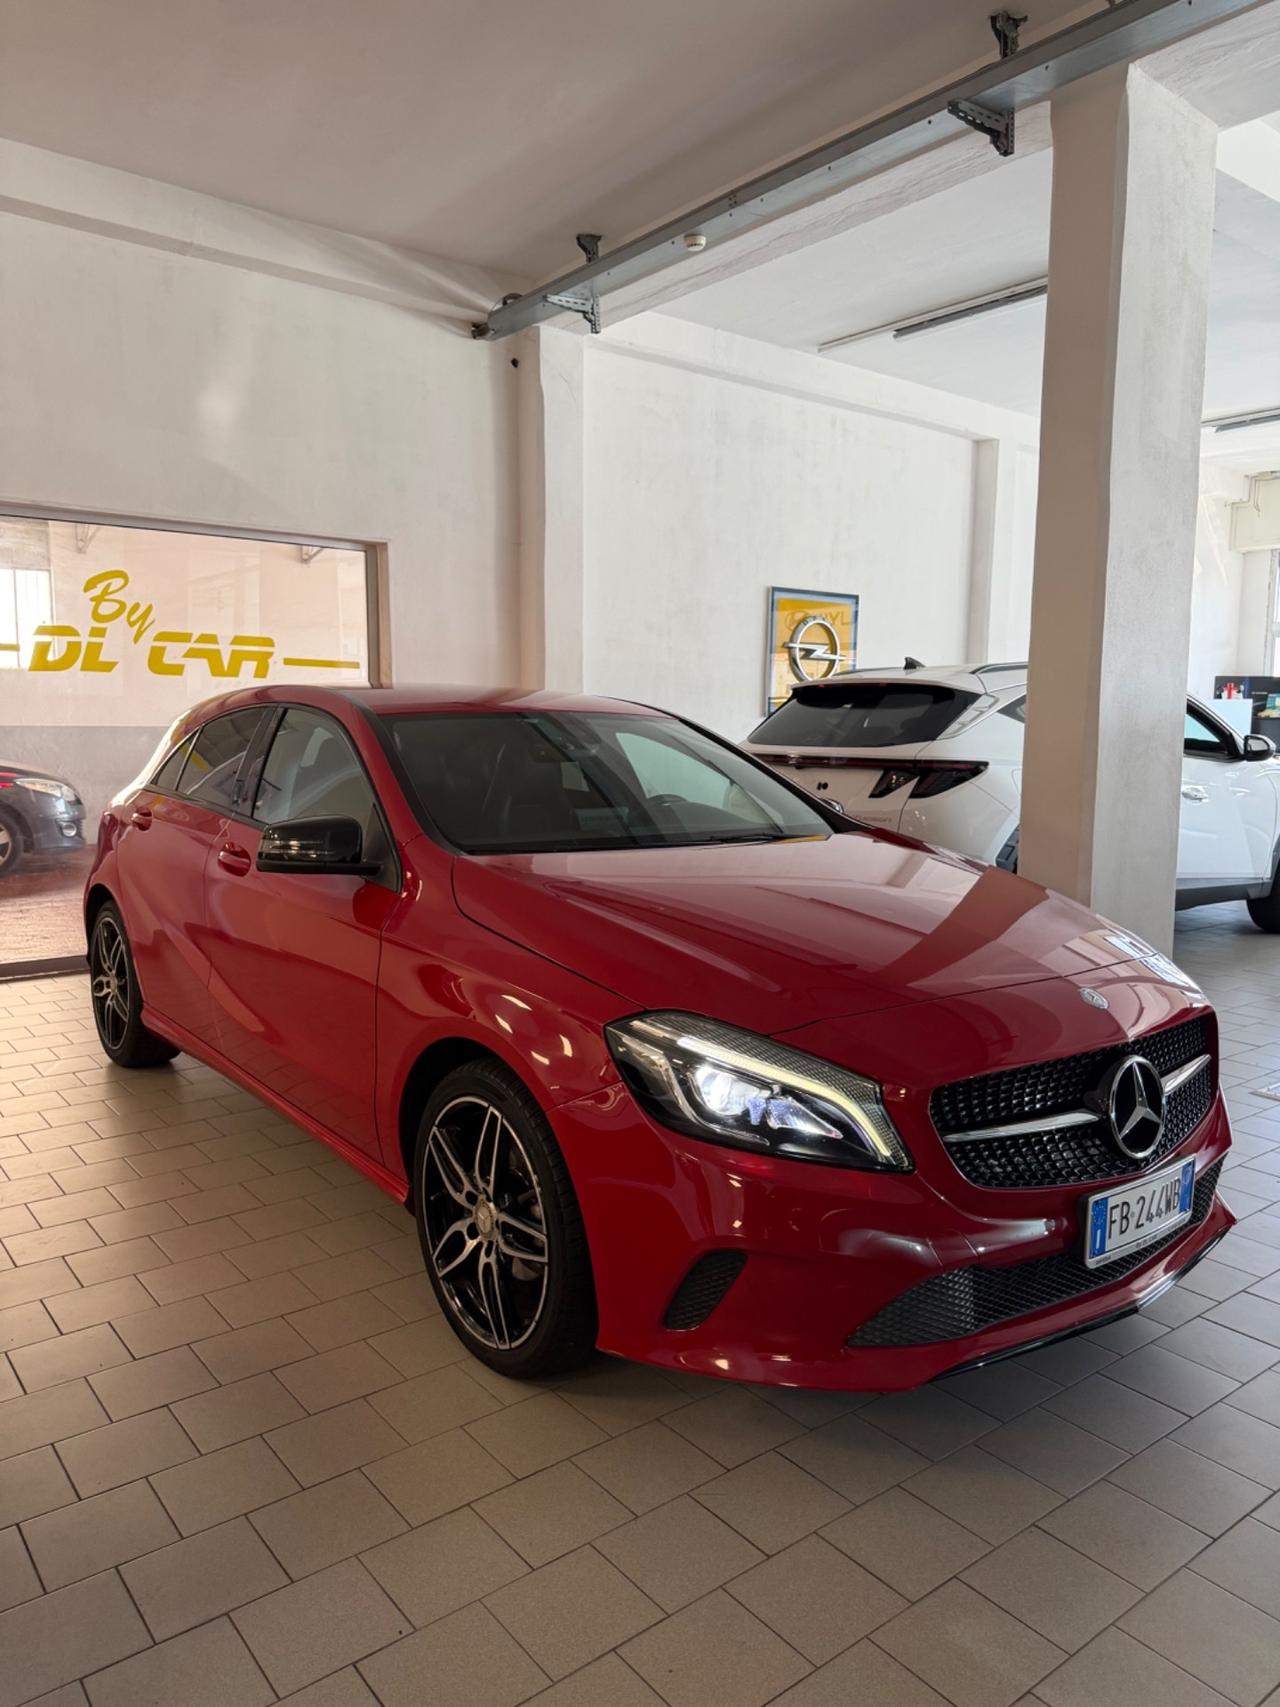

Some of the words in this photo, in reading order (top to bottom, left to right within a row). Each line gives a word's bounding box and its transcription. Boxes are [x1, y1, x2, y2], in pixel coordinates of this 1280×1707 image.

[83, 569, 155, 644] By
[28, 625, 120, 673] DL
[147, 631, 275, 678] CAR
